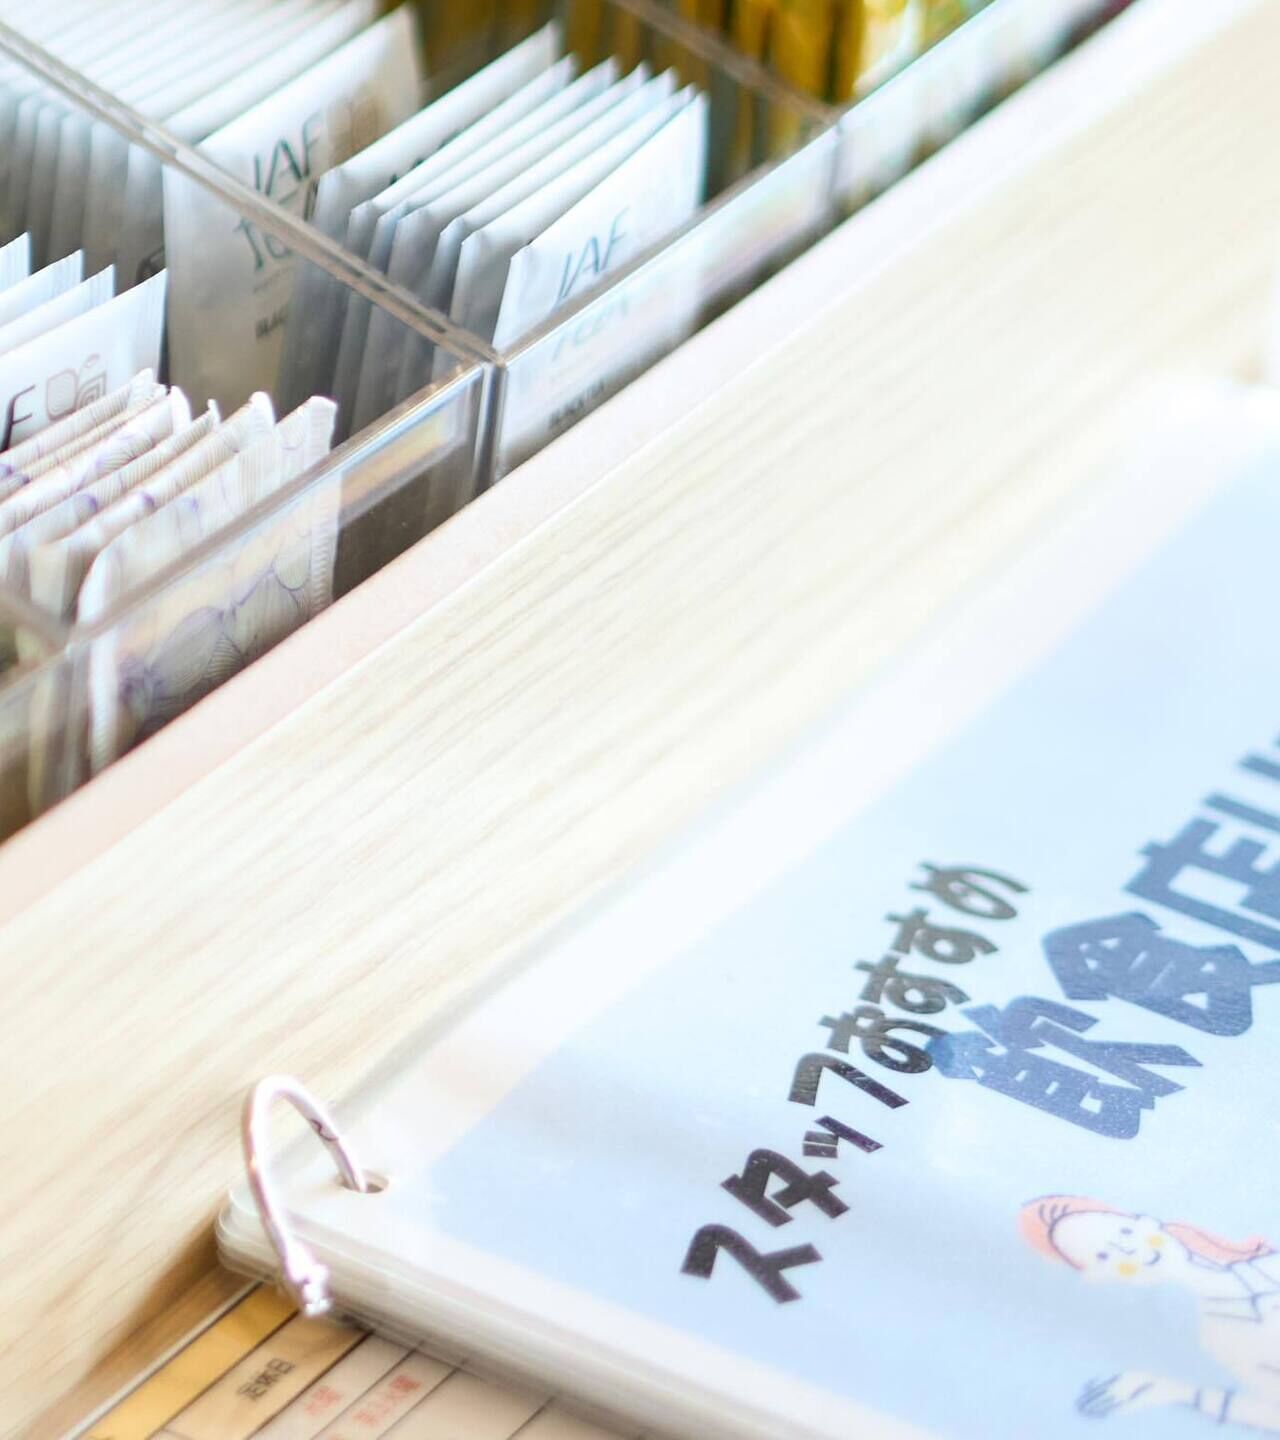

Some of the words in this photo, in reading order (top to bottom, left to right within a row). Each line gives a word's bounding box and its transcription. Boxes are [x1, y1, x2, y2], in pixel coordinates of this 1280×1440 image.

[679, 860, 1031, 1306] スタッフおすすめ
